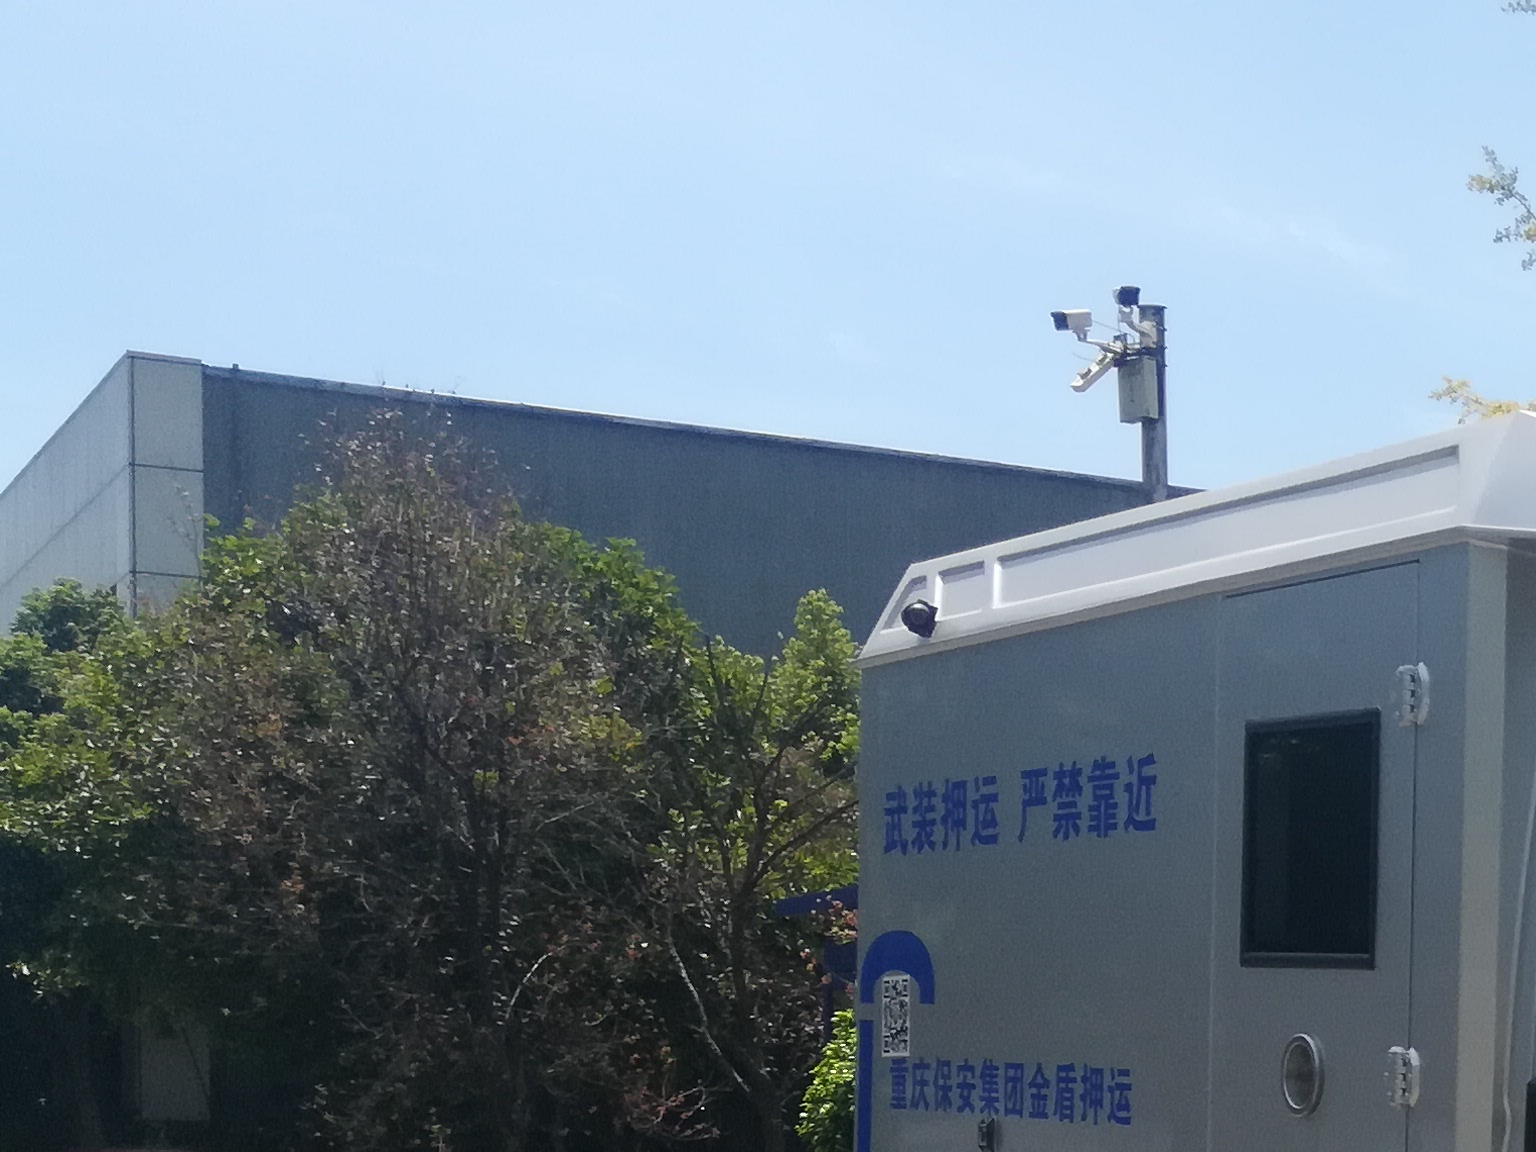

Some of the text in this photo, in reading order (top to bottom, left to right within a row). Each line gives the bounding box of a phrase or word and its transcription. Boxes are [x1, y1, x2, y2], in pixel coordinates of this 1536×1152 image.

[883, 752, 1158, 857] 武装押运 严禁靠近
[889, 1058, 1133, 1126] 重庆保安集团金盾押运
